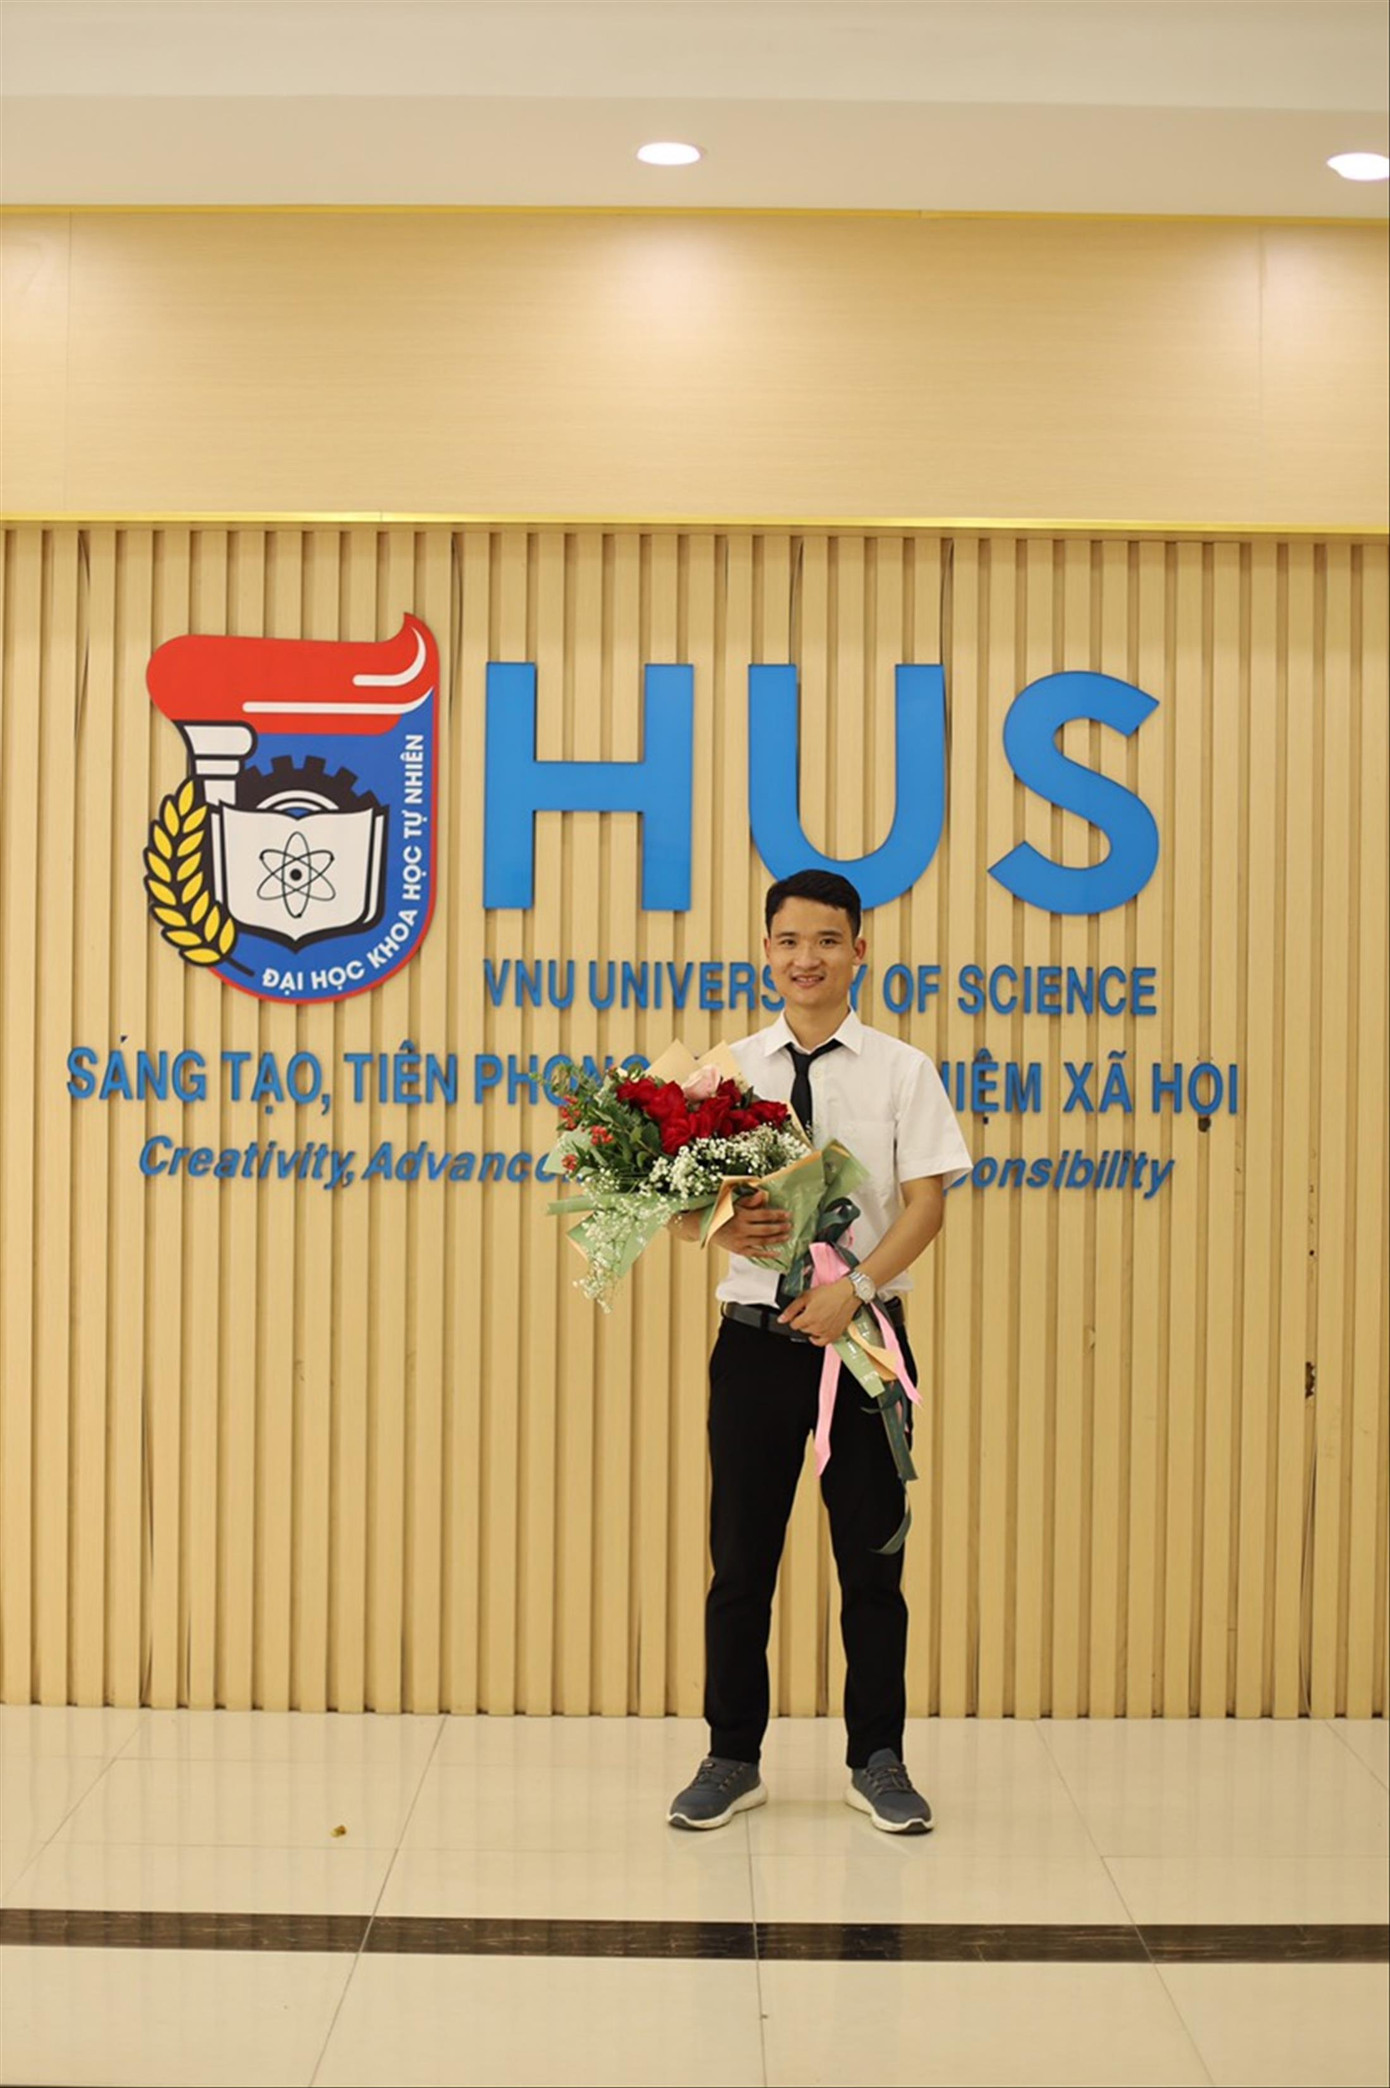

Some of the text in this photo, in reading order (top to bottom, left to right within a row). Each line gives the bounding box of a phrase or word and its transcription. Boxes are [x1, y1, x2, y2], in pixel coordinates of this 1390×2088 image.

[482, 661, 1160, 915] HUS
[262, 733, 428, 996] ĐẠI HỌC KHOA HỌC TỰ NHIÊN
[483, 958, 1157, 1016] VNU UNIVERSY OF SCIENCE
[66, 1033, 206, 1102] SÁNG
[220, 1050, 331, 1116] TẠO,
[343, 1038, 458, 1105] TIÊN
[1062, 1049, 1134, 1114] XÃ
[138, 1134, 355, 1191] Creativity,
[942, 1149, 1176, 1200] onsibility
